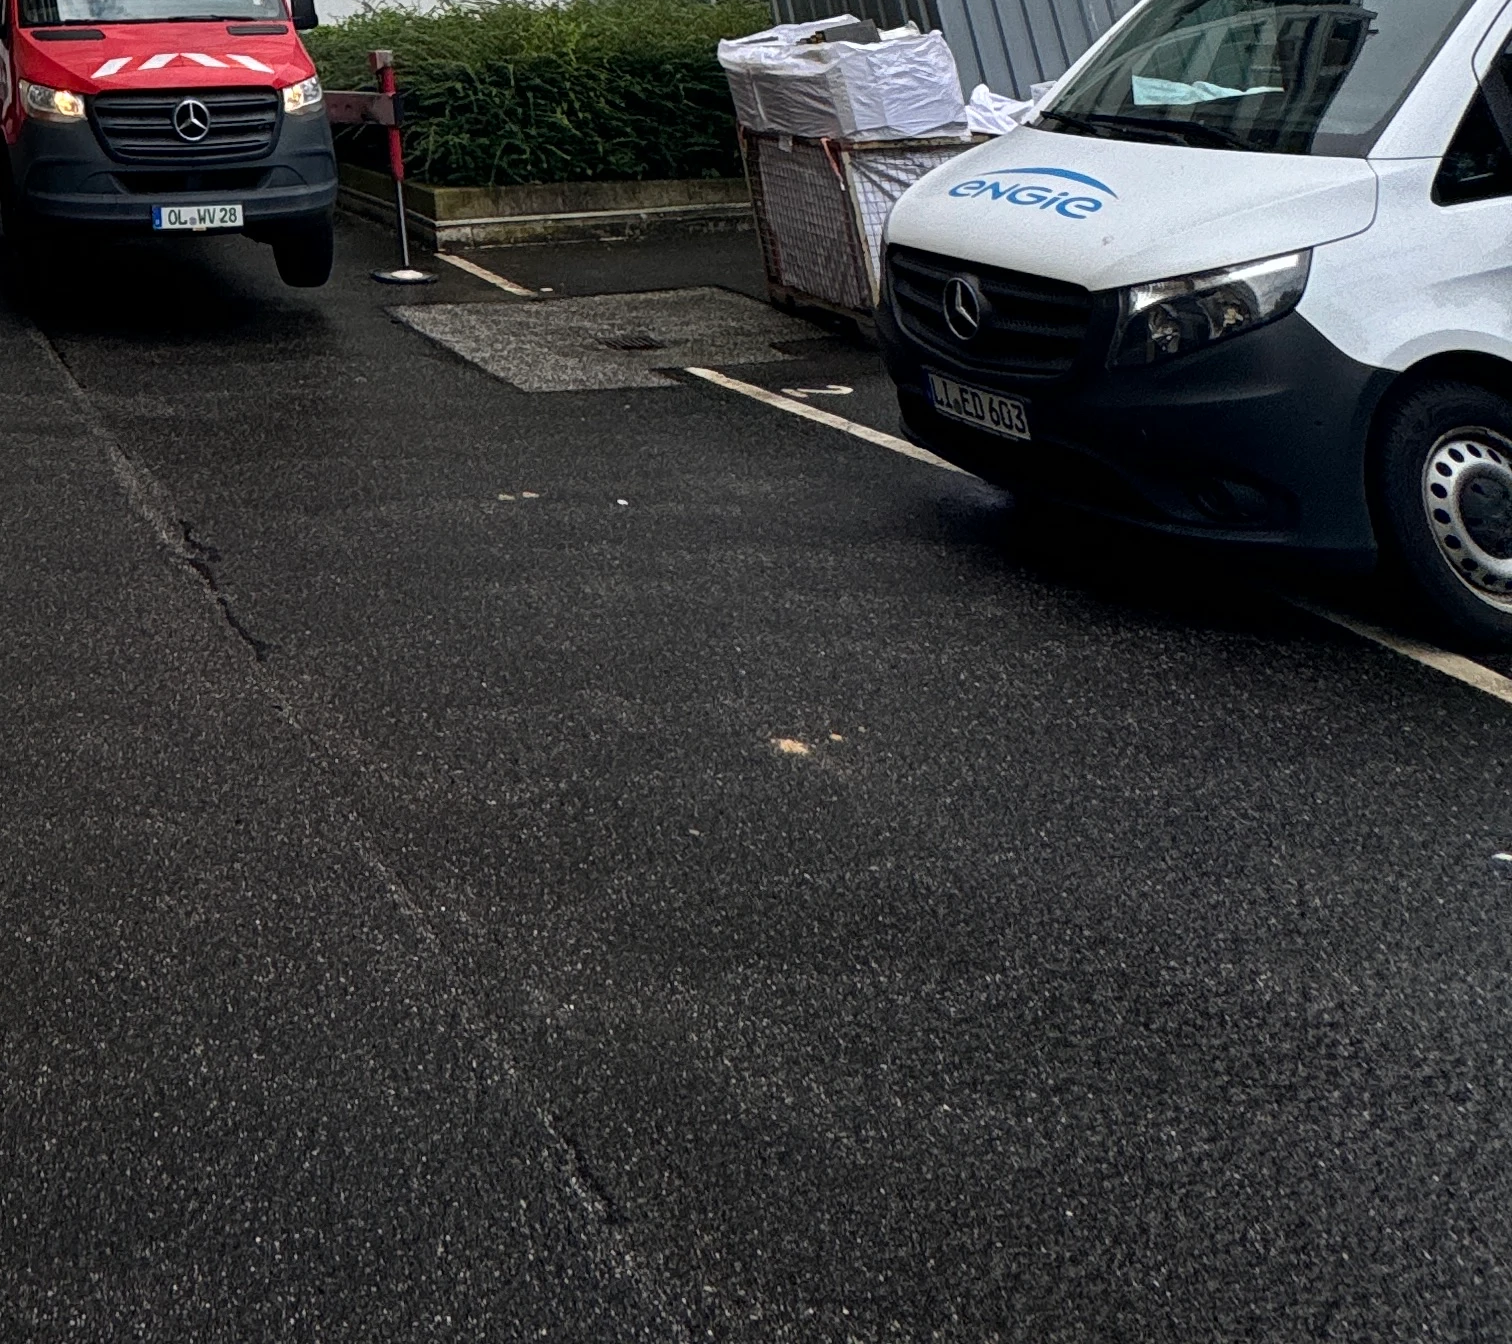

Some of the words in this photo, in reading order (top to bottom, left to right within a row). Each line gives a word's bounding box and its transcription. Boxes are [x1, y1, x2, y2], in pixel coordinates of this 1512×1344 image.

[168, 209, 188, 225] OL
[197, 208, 216, 224] WV
[219, 207, 237, 223] 28
[931, 377, 953, 409] LI
[959, 386, 985, 421] ED
[989, 396, 1026, 434] 603
